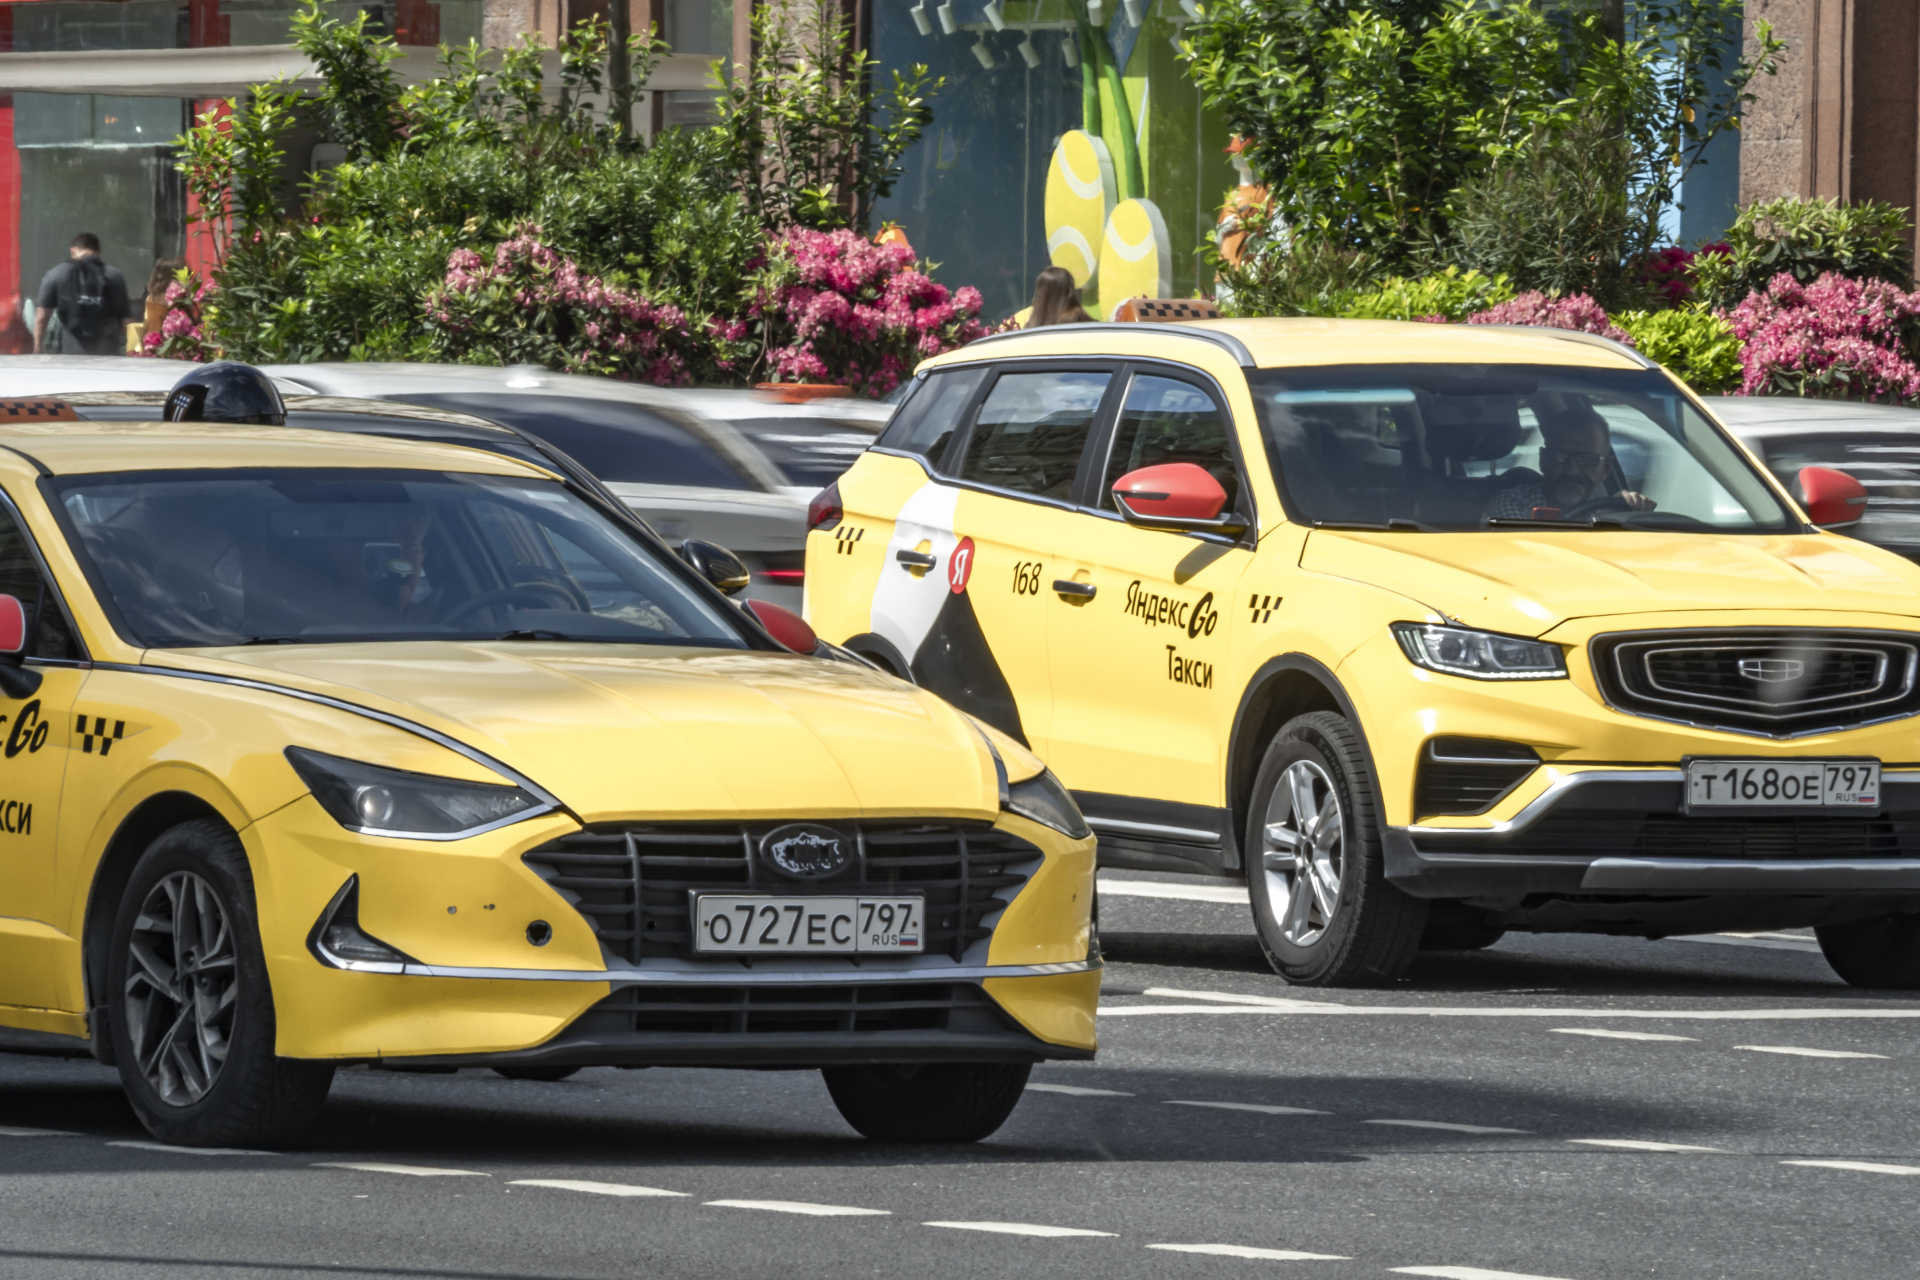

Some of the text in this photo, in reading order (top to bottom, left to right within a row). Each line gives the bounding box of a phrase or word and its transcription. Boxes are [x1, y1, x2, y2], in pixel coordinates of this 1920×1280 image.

[951, 548, 970, 585] Я
[1012, 561, 1042, 595] 168
[1165, 644, 1213, 689] Такси
[1827, 767, 1872, 791] 797
[1835, 793, 1858, 802] RUS
[860, 903, 912, 933] 797
[872, 934, 898, 946] RUS
